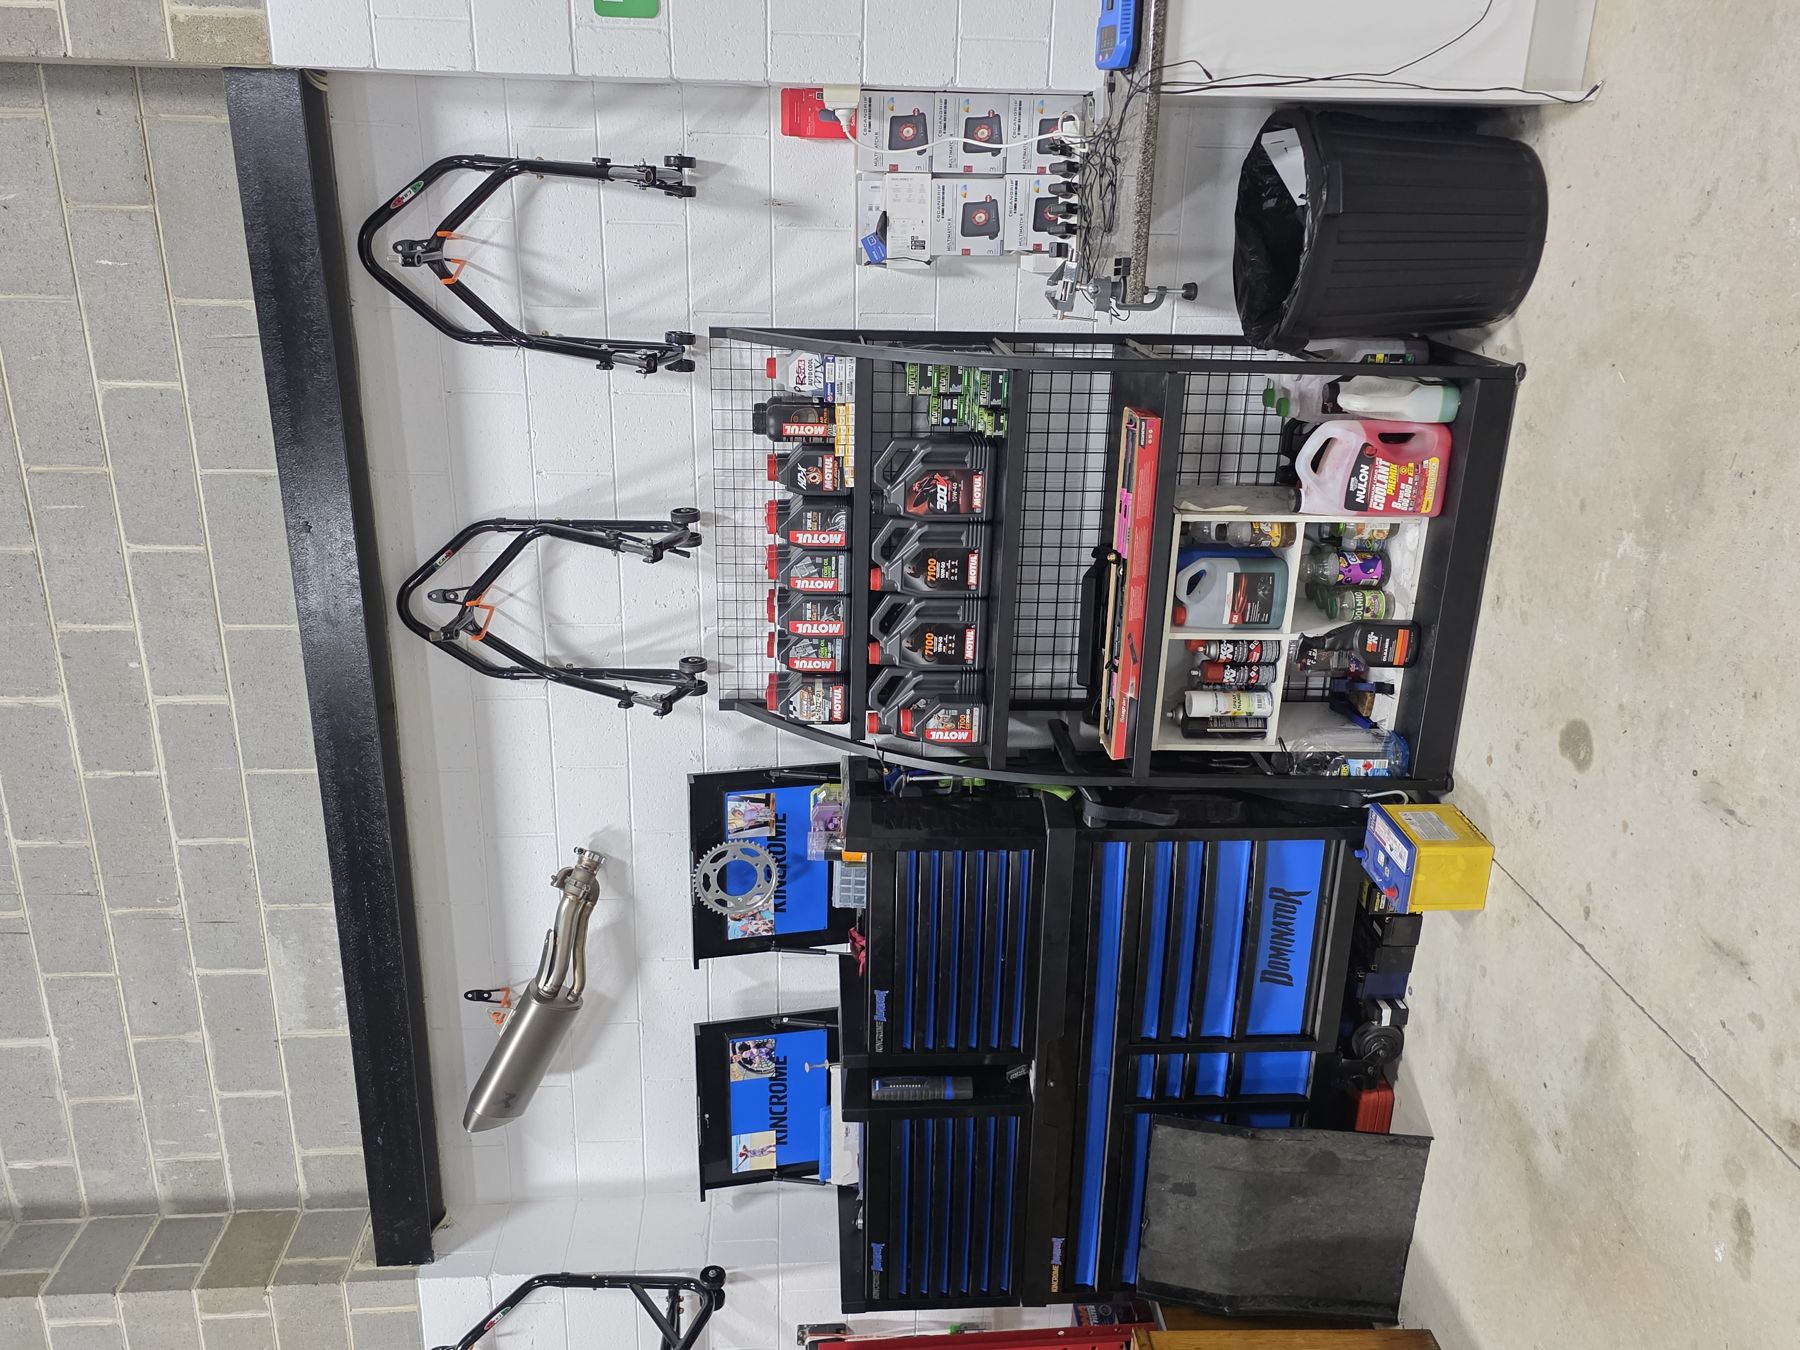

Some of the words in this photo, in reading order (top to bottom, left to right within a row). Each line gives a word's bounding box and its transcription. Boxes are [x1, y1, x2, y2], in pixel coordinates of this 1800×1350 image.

[785, 426, 825, 434] MOTUL
[798, 463, 806, 490] HD-X
[824, 457, 832, 489] MOTUL
[1356, 464, 1369, 503] NULON
[1372, 458, 1390, 510] COOLANT
[1386, 462, 1398, 495] PREMIX
[936, 473, 948, 512] 300V
[796, 534, 842, 544] MOTUL
[928, 558, 936, 582] 7100
[796, 580, 834, 588] MOTUL
[1353, 592, 1363, 620] DOLMIO
[796, 624, 840, 634] MOTUL
[924, 632, 934, 656] 7100
[794, 660, 832, 668] MOTUL
[834, 688, 842, 719] MOTUL
[930, 732, 968, 740] MOTUL
[1260, 886, 1312, 987] DOMINATOR
[768, 1056, 788, 1145] KINCROME
